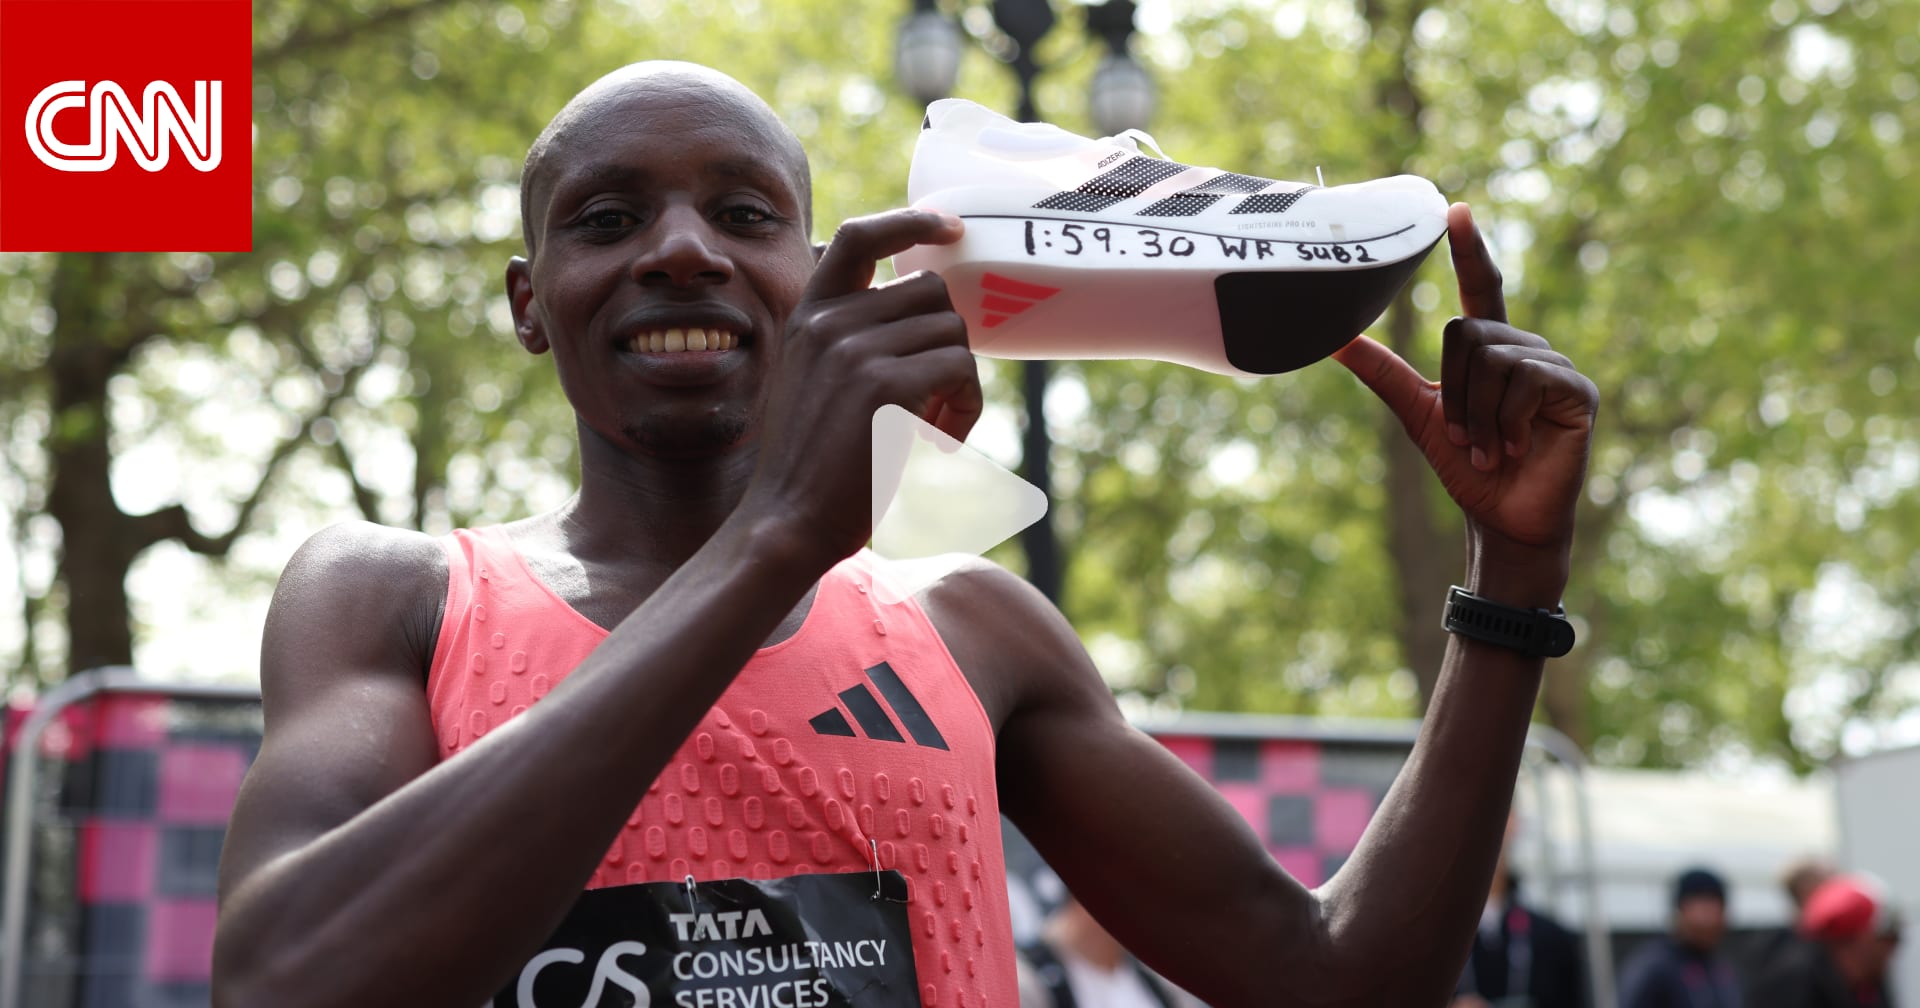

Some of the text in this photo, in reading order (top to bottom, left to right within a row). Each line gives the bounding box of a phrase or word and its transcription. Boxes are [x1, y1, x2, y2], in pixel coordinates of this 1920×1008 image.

[1097, 150, 1125, 169] ADIZERO
[1024, 220, 1195, 257] 1:59.30
[1217, 236, 1274, 260] WR
[669, 908, 773, 942] TATA
[672, 939, 887, 981] CONSULTANCY
[674, 978, 830, 1008] SERVICES
